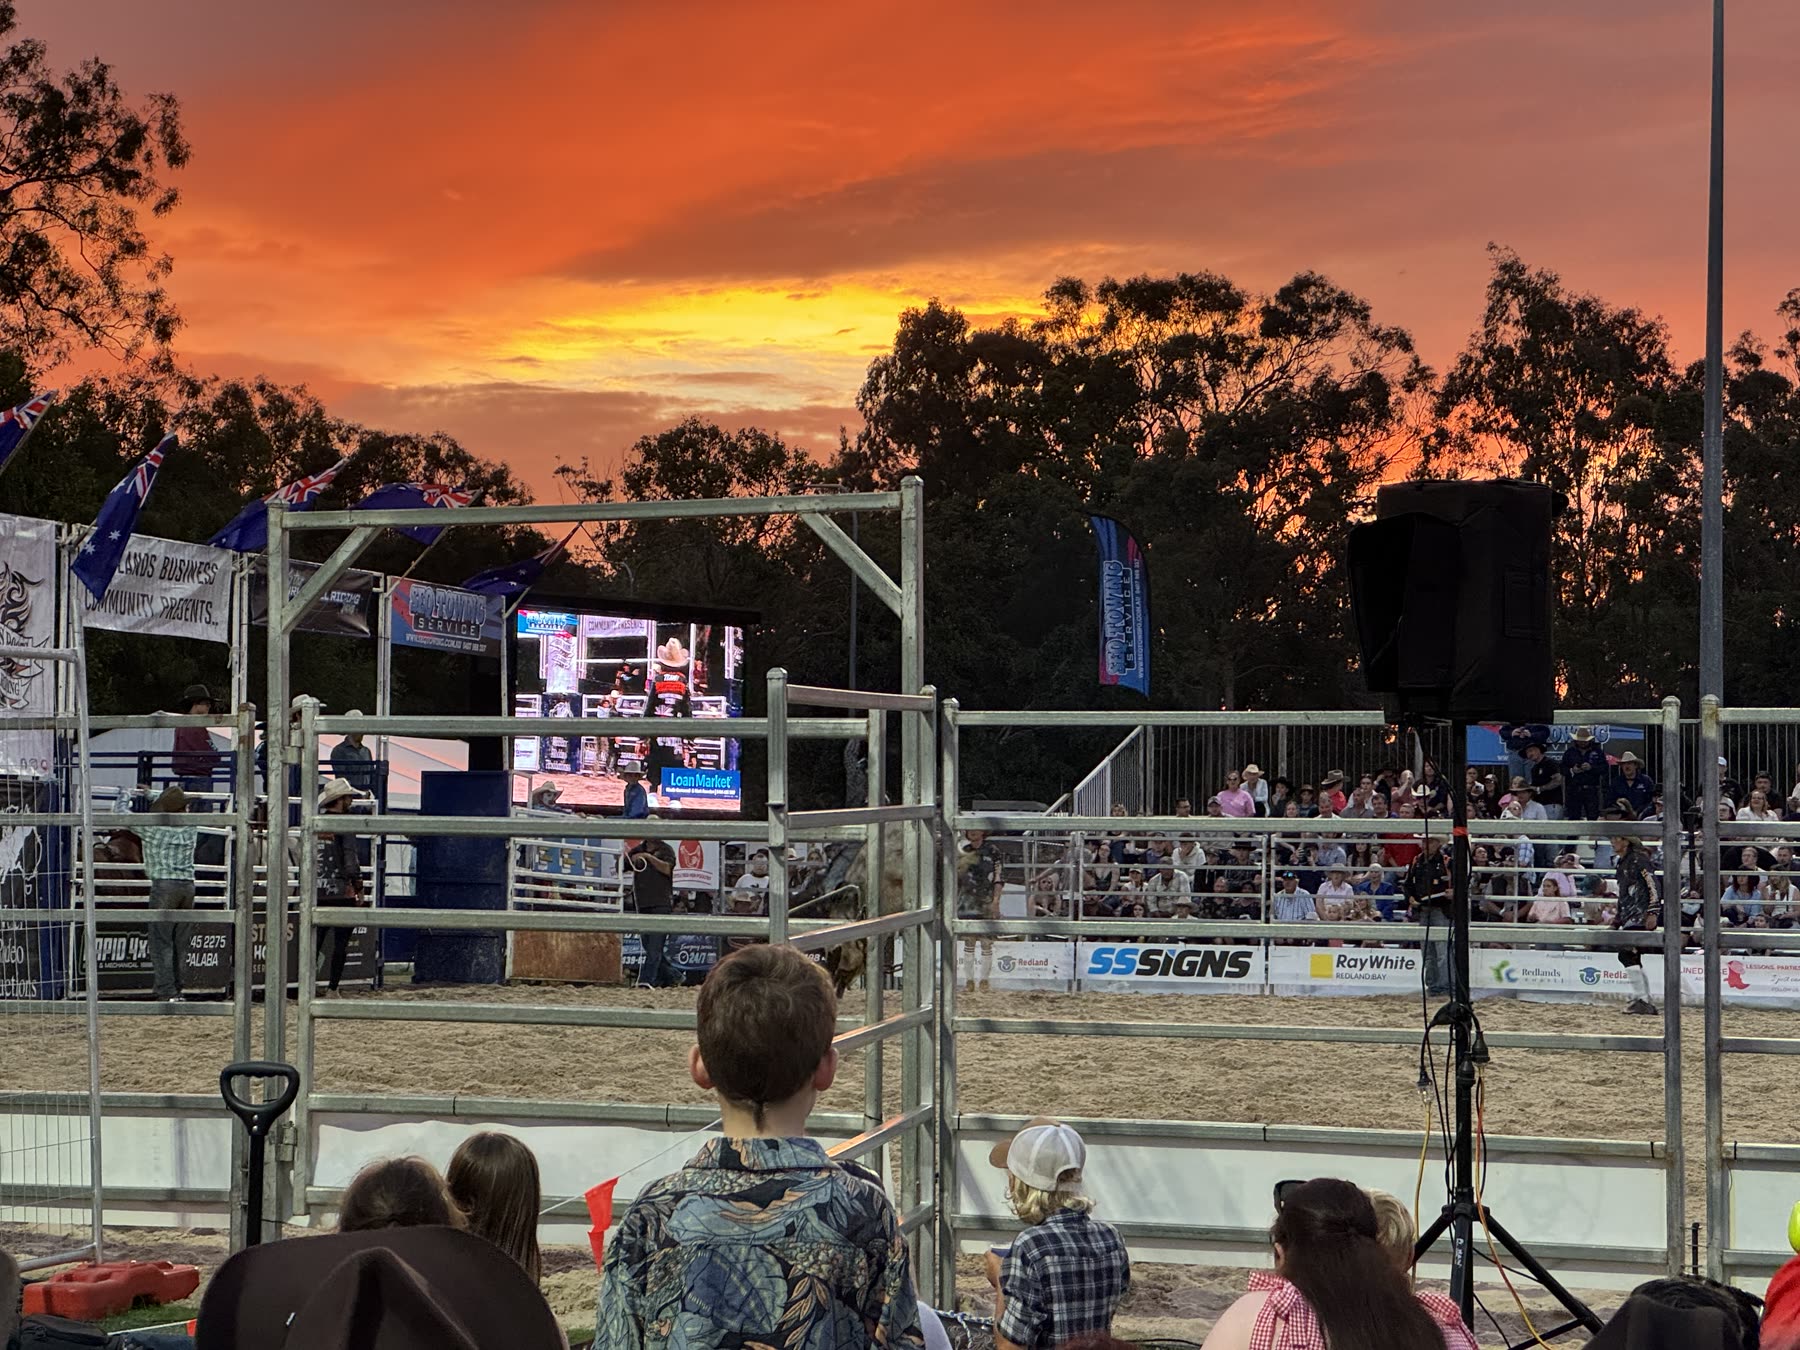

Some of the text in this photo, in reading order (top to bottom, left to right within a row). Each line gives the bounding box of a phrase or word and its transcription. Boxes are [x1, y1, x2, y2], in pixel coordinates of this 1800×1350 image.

[118, 551, 219, 585] LANDS BUSINESS
[84, 588, 154, 618] CMMUNITY
[436, 588, 486, 625] TOWING
[418, 617, 476, 636] SERVICE
[1104, 560, 1127, 675] SEQ TOWING
[1124, 576, 1134, 661] SERVICE
[203, 935, 226, 949] 2275
[1018, 958, 1049, 966] Redland
[1336, 972, 1371, 980] REDLAND
[1522, 968, 1561, 978] Redlands
[1603, 970, 1629, 979] Redla
